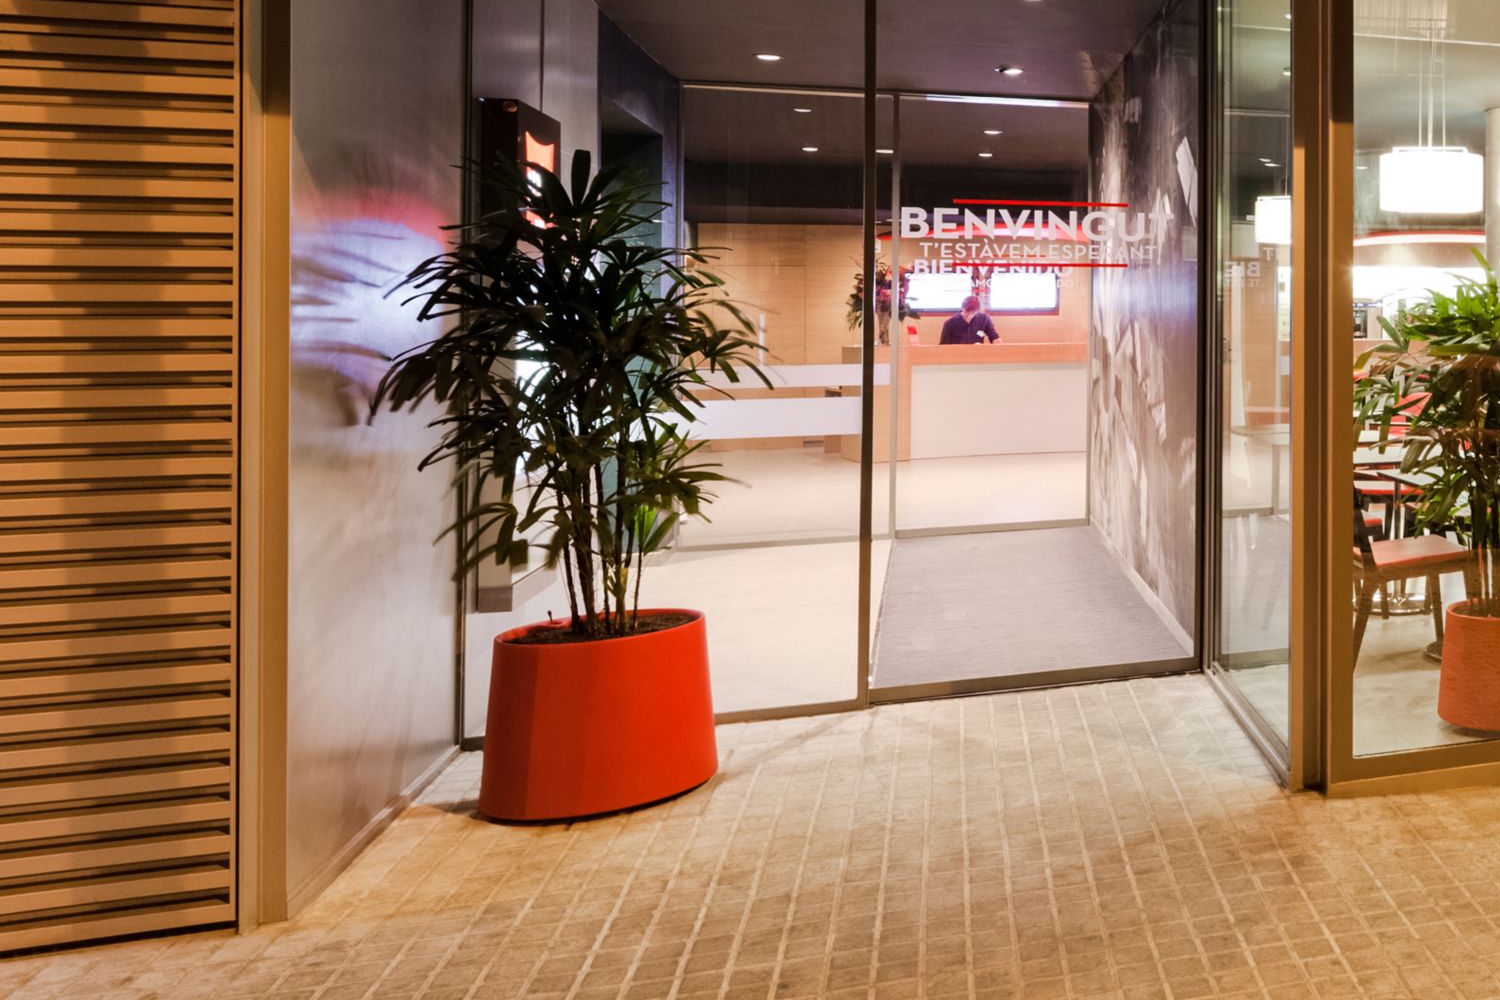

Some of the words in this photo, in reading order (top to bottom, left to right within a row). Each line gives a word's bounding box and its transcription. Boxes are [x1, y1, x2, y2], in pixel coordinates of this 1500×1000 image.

[900, 206, 1174, 242] BENVINGUT
[1050, 244, 1157, 261] ESPERANT
[913, 258, 1073, 278] BIENVENIDO
